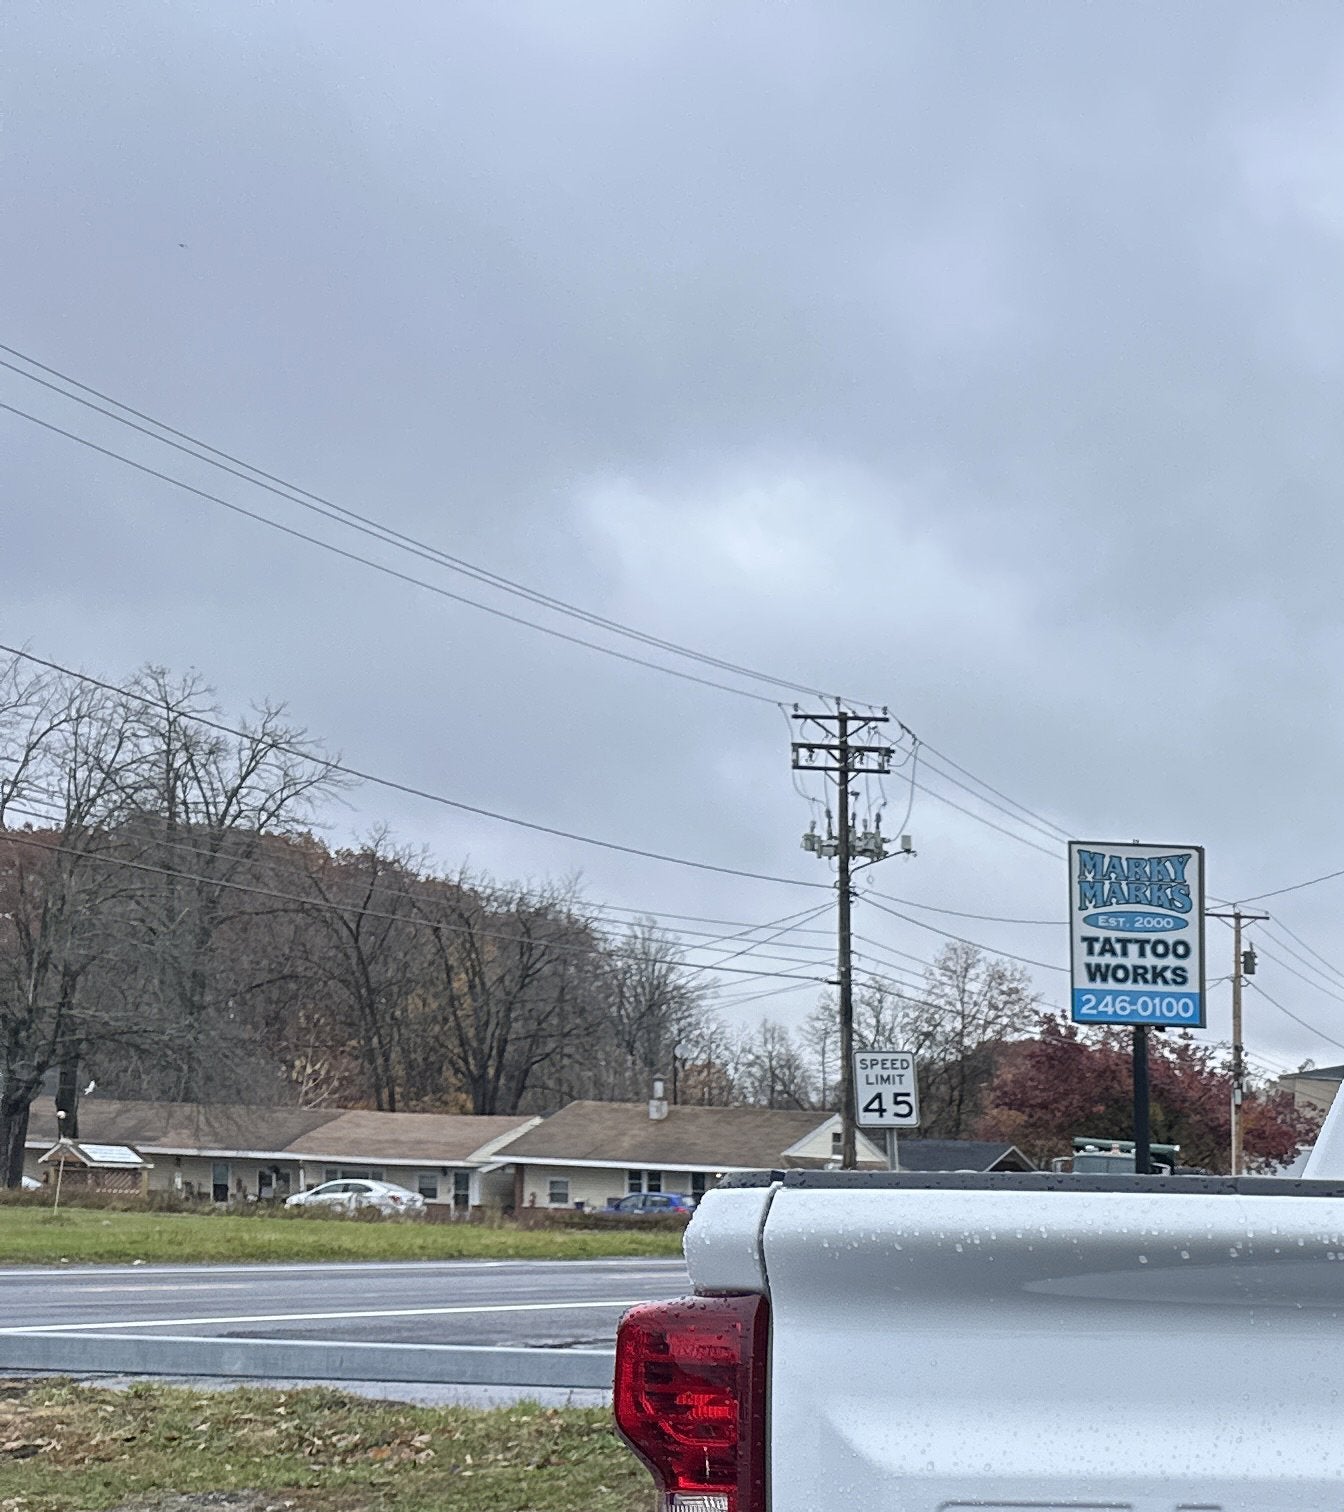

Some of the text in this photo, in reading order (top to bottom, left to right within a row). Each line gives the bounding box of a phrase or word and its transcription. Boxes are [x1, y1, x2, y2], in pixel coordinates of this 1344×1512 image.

[1077, 849, 1191, 883] MARKY
[1078, 881, 1193, 914] MARKS
[1134, 916, 1174, 929] 2000
[1081, 936, 1192, 960] TATTOO
[1084, 962, 1189, 986] WORKS
[1080, 993, 1195, 1018] 246-0100
[859, 1058, 910, 1071] SPEED
[865, 1074, 905, 1086] LIMIT
[862, 1092, 914, 1119] 45
